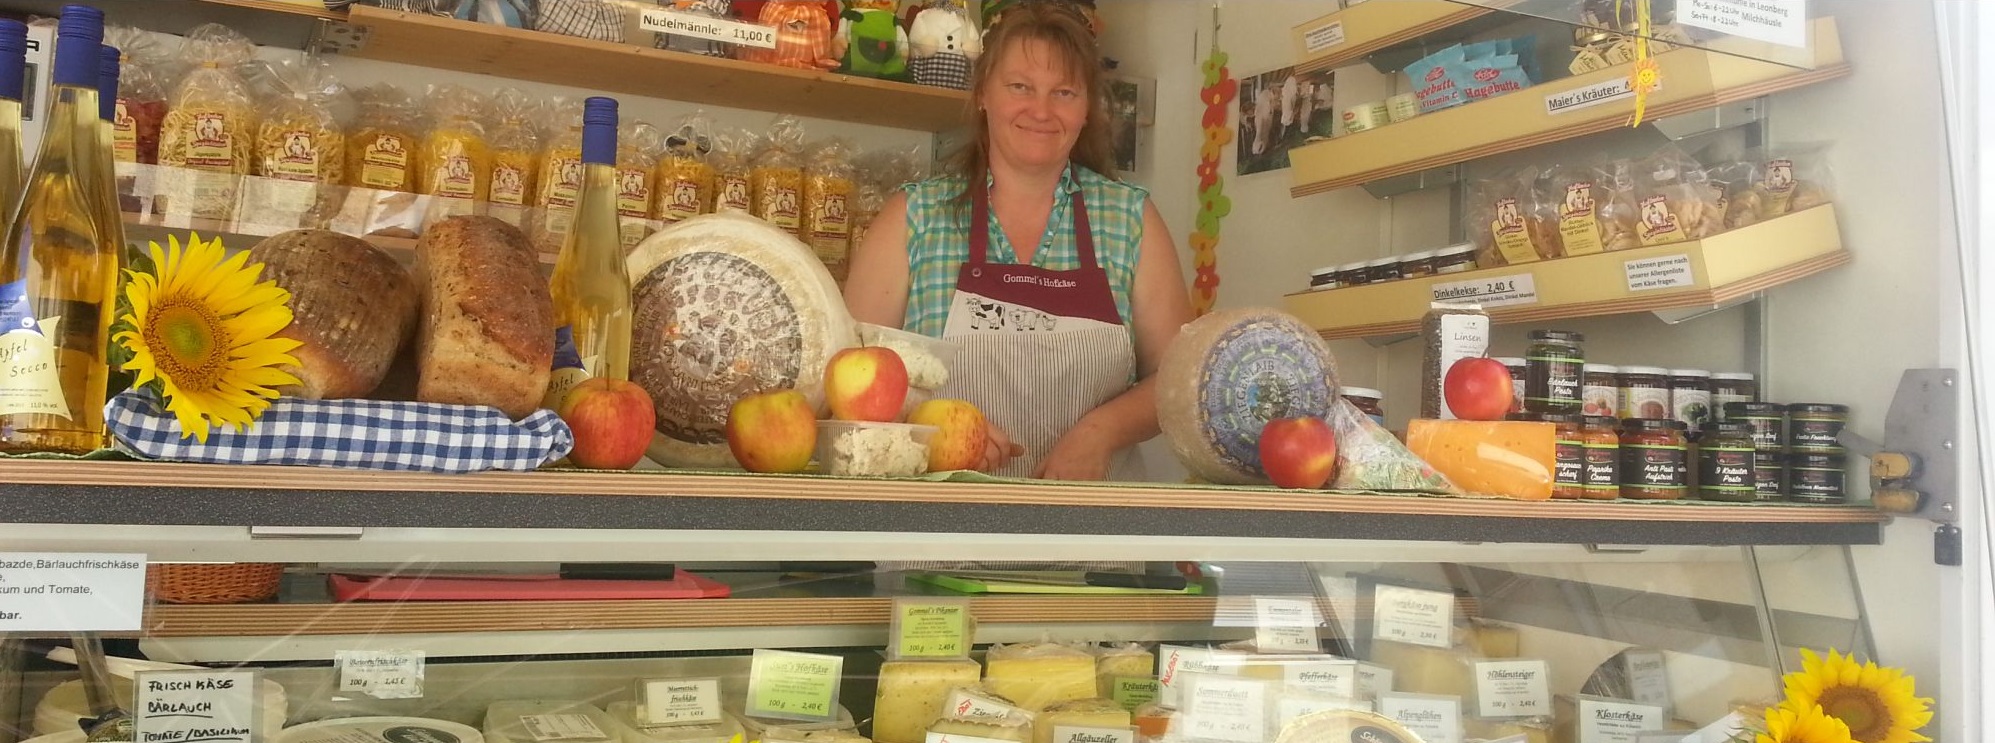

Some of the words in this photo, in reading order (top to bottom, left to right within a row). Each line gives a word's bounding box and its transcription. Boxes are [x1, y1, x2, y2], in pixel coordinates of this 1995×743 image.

[1758, 2, 1788, 17] Leonberg
[643, 15, 722, 36] Nudelmännle:
[733, 28, 762, 42] 11,00
[765, 33, 772, 43] €
[1465, 81, 1520, 98] Hagebutte
[1582, 85, 1620, 100] Kräuter:
[1657, 260, 1673, 268] gerne
[1043, 277, 1077, 288] Hofkäse
[1434, 286, 1480, 298] Dinkelkekse:
[1487, 282, 1505, 293] 2,40
[1508, 280, 1515, 290] €
[1454, 332, 1482, 342] Linsen
[9, 363, 48, 378] Secco
[24, 584, 45, 594] und
[48, 584, 93, 596] Tomate,
[0, 610, 22, 620] bar.
[350, 678, 362, 686] 100
[1487, 670, 1536, 680] Höhlensteiger
[148, 680, 192, 692] FRISCH
[196, 678, 234, 690] KÄSE
[148, 698, 212, 713] BÄRLAUCH
[1596, 708, 1644, 722] Klosterkäse
